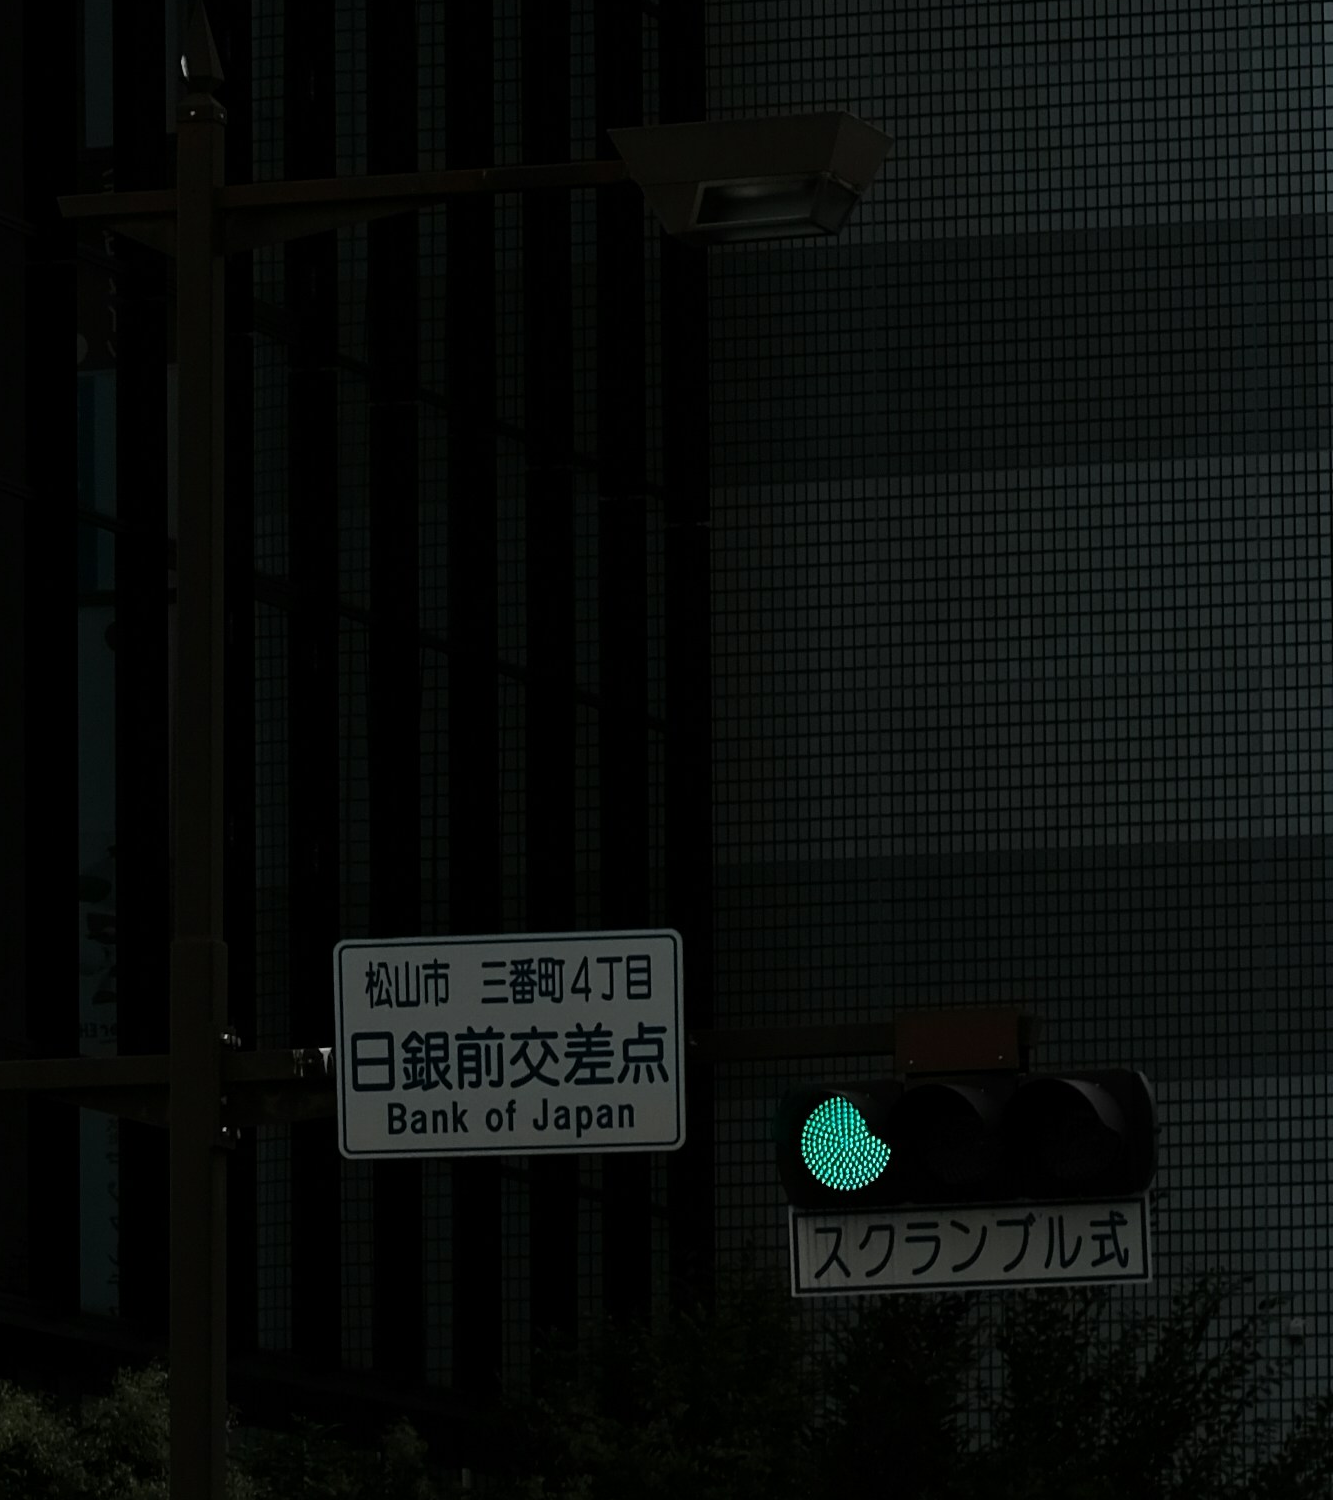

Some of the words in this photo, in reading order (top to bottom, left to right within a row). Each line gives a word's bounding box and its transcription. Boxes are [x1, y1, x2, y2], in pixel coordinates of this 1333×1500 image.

[364, 960, 450, 1009] 松山市
[481, 954, 654, 1003] 三番町4丁目
[351, 1022, 669, 1093] 日銀前交差点
[387, 1102, 468, 1136] Bank
[484, 1100, 517, 1134] of
[533, 1098, 635, 1139] Japan
[813, 1211, 1130, 1279] スクランブル式
